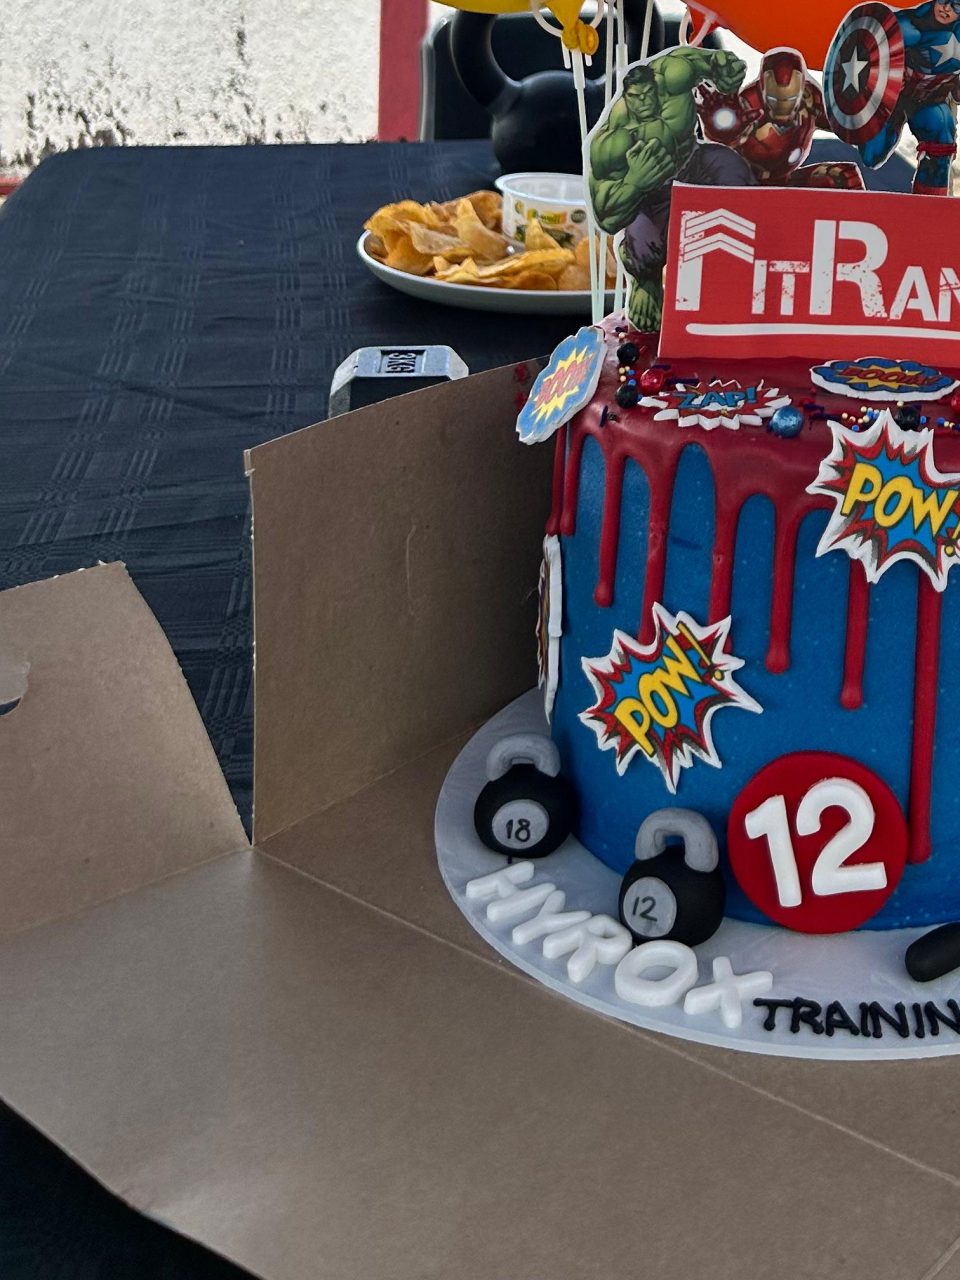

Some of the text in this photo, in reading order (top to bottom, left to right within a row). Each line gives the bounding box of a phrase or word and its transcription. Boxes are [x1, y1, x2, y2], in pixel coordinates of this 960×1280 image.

[386, 352, 416, 373] 3KG
[677, 386, 757, 409] ZAP!
[613, 620, 725, 758] POW!
[505, 818, 532, 843] 18
[744, 776, 888, 908] 12
[632, 895, 658, 922] 12
[466, 860, 773, 1028] HYROX
